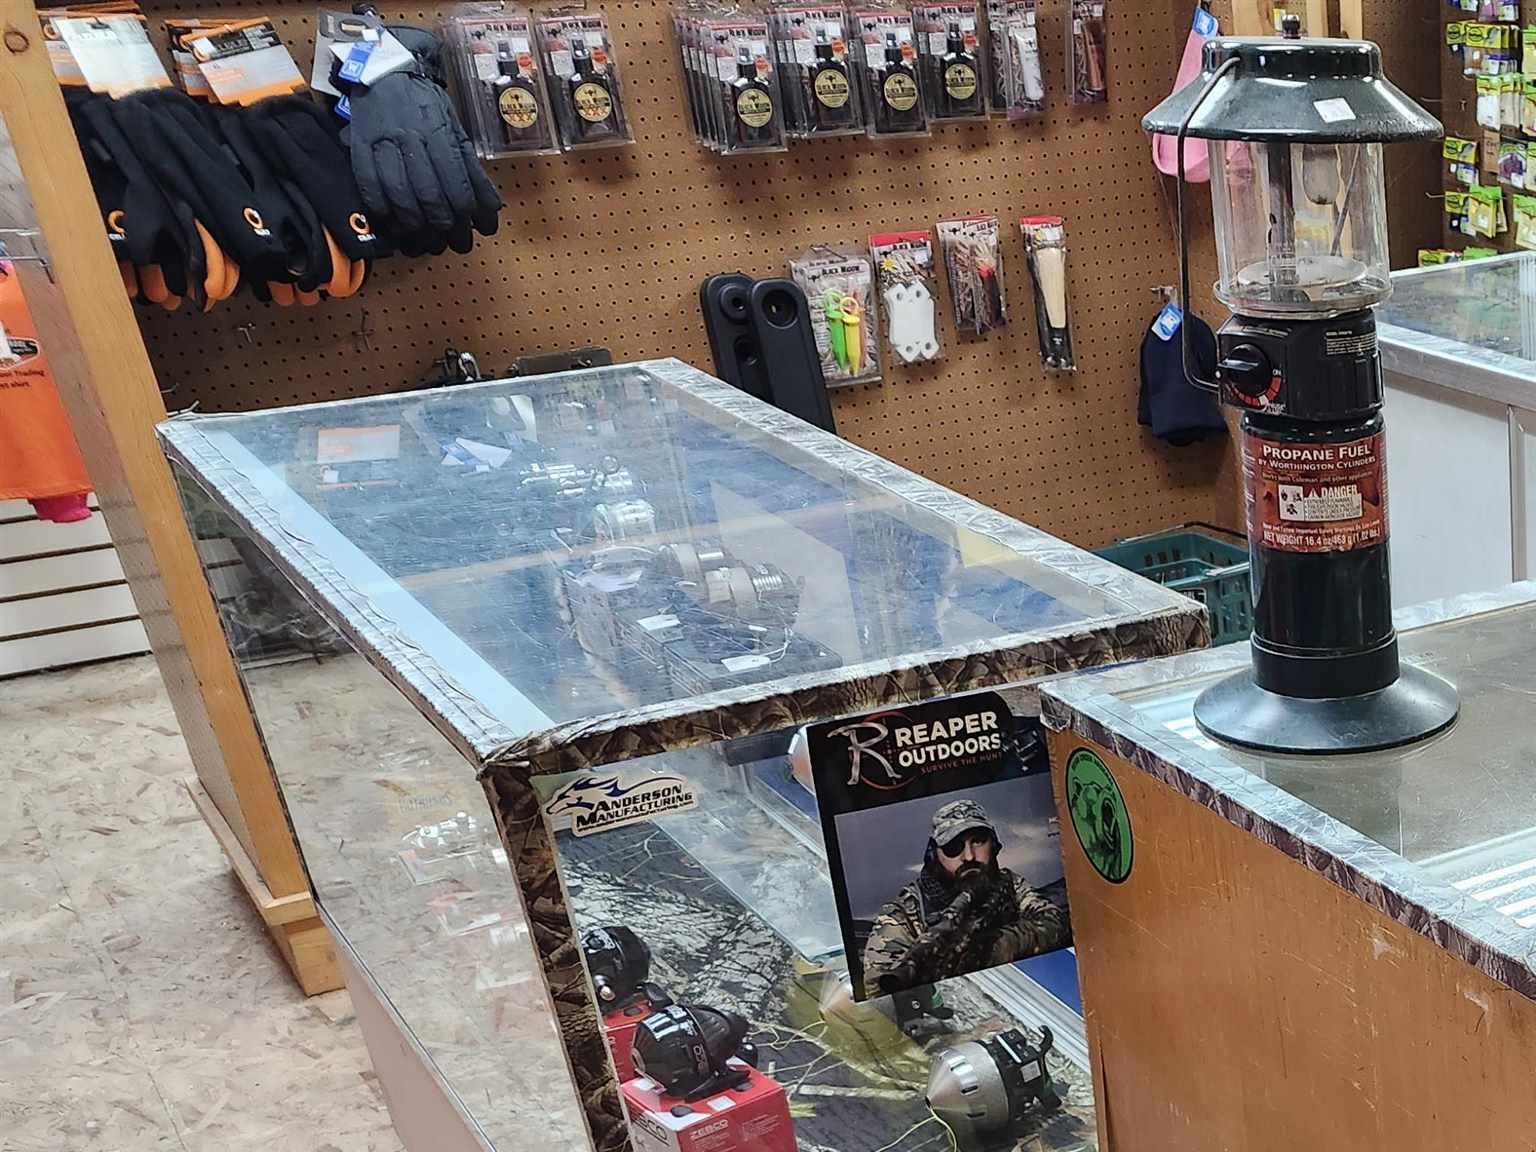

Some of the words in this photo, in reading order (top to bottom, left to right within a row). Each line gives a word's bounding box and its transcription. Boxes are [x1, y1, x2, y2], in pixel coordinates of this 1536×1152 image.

[1263, 445, 1334, 460] PROPANE
[1339, 444, 1371, 459] FUEL
[1269, 460, 1334, 471] WORTHINGTON
[1336, 455, 1376, 469] CYLINDERS
[1321, 484, 1358, 497] DANGER
[1275, 532, 1303, 545] WEIGHT
[895, 711, 998, 747] REAPER
[898, 733, 1001, 768] OUTDOORS
[596, 784, 682, 812] ANDERSON
[576, 792, 692, 828] MANUFACTURING
[690, 1119, 730, 1140] ZEBCO
